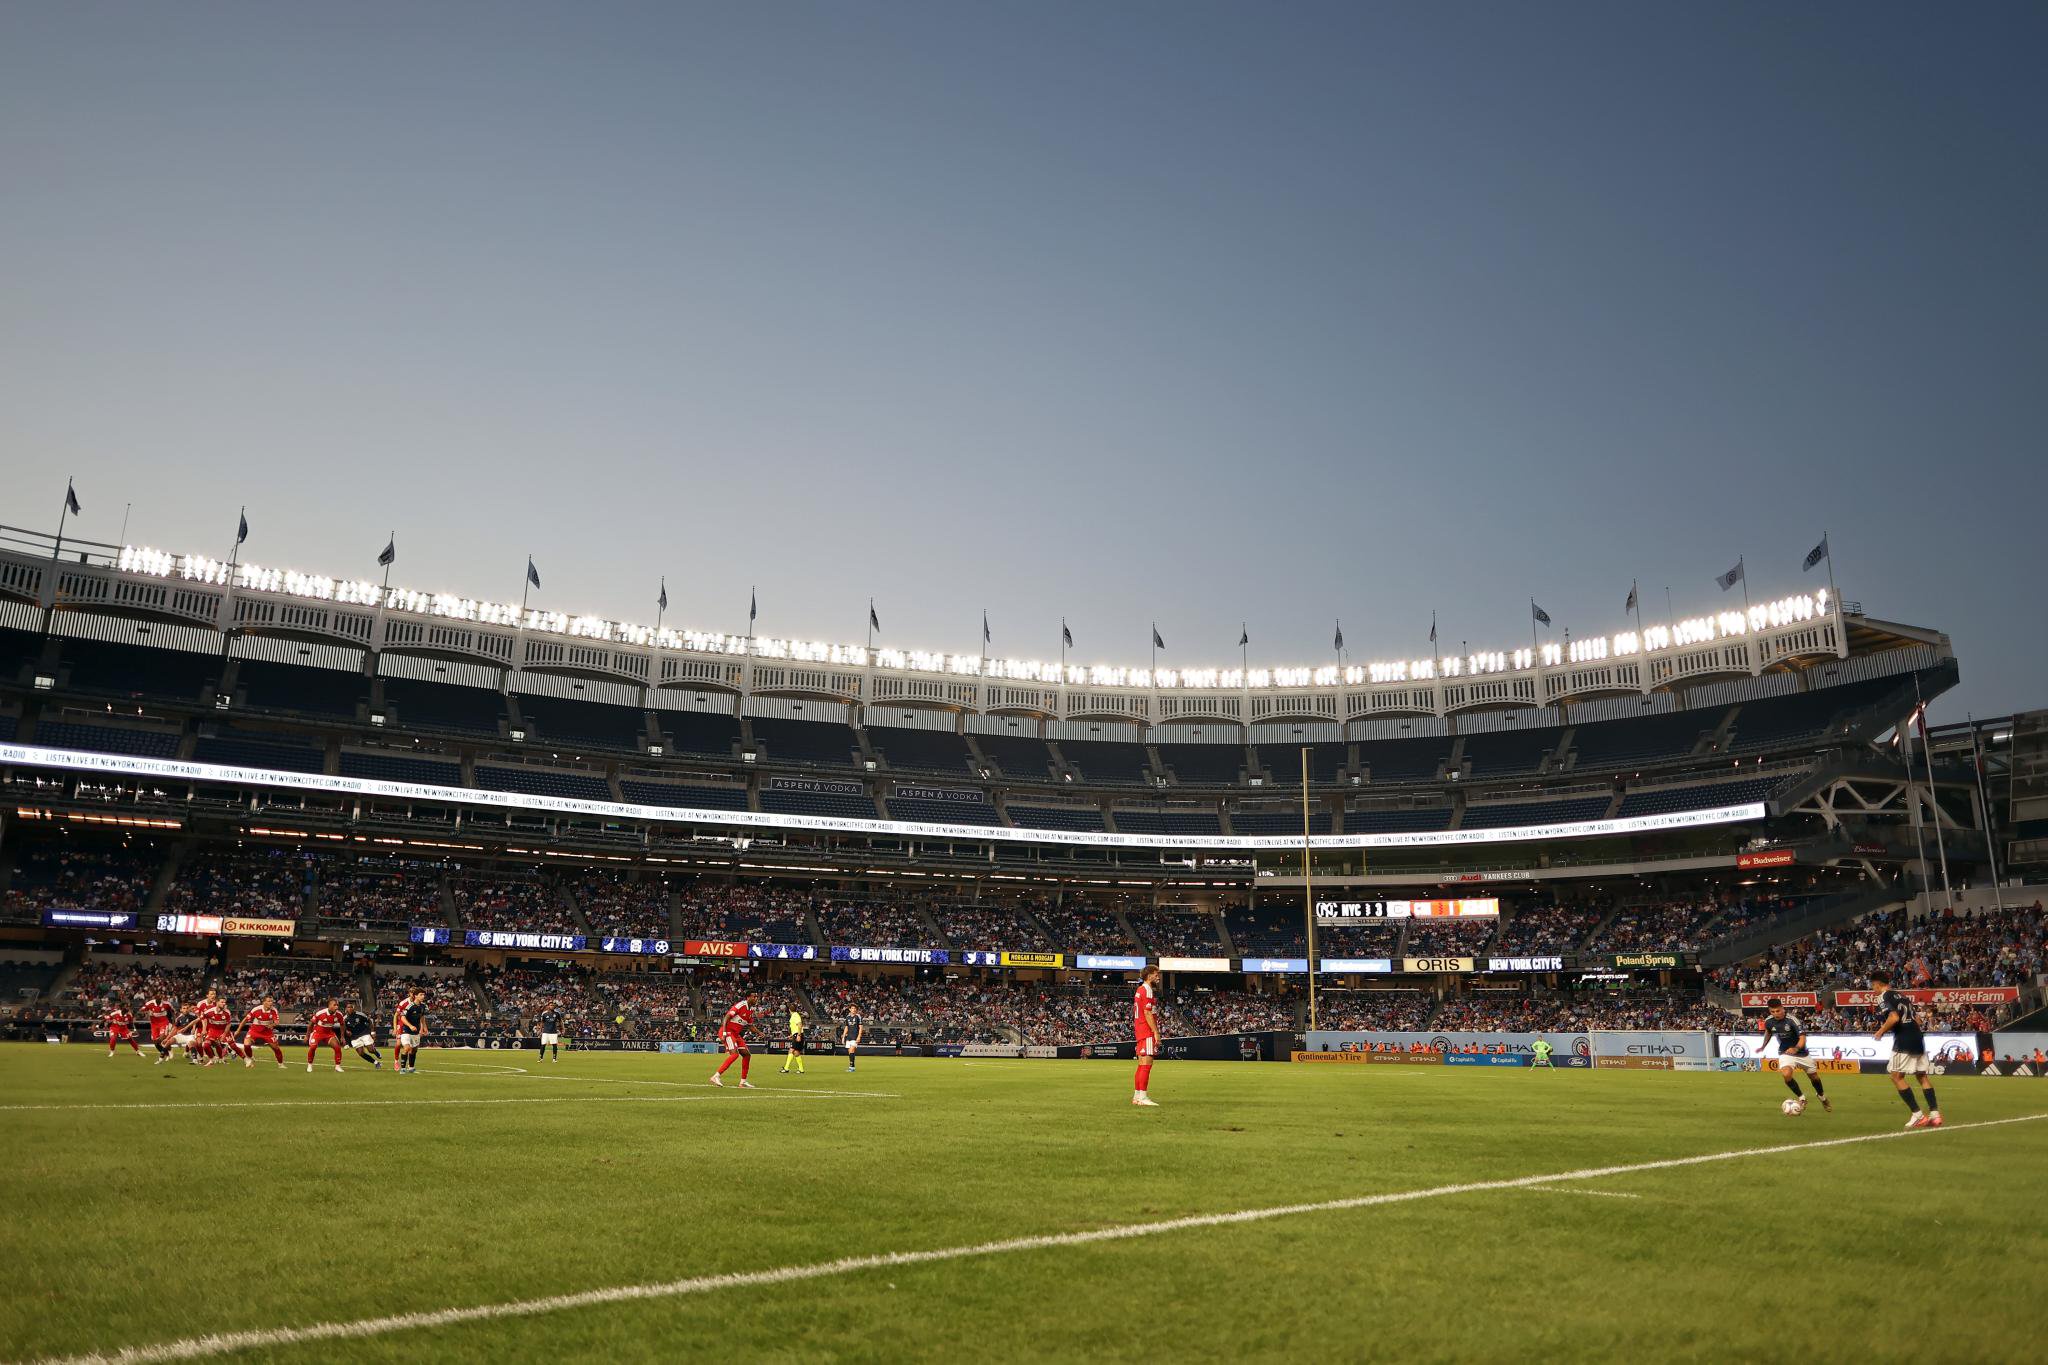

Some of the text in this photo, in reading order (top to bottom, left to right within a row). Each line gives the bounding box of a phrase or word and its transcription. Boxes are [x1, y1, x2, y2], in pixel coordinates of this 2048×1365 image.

[46, 753, 71, 763] LISTEN
[73, 756, 88, 765] LIVE
[90, 757, 99, 766] AT
[220, 770, 243, 778] LISTEN
[244, 772, 258, 780] LIVE
[378, 784, 399, 792] LISTEN
[776, 782, 858, 792] ASPEN VODKA
[901, 790, 979, 801] ASPEN VODKA
[1629, 820, 1647, 828] LISTEN
[1753, 856, 1792, 865] Budweiser
[1460, 874, 1482, 882] Audi
[1342, 904, 1362, 916] NYC
[1375, 902, 1382, 916] 3
[168, 916, 176, 930] 3
[239, 923, 290, 932] KIKKOMAN
[492, 933, 573, 948] NEW YORK CITY FC
[699, 943, 733, 955] AVIS
[861, 949, 931, 962] NEW YORK CITY FC
[1616, 954, 1676, 967] Poland Spring
[1417, 959, 1460, 971] ORIS
[1489, 958, 1562, 971] NEW YORK CITY FC
[1627, 1045, 1685, 1054] ETIHAD
[1298, 1053, 1337, 1062] Continental
[1828, 1060, 1852, 1070] Tire
